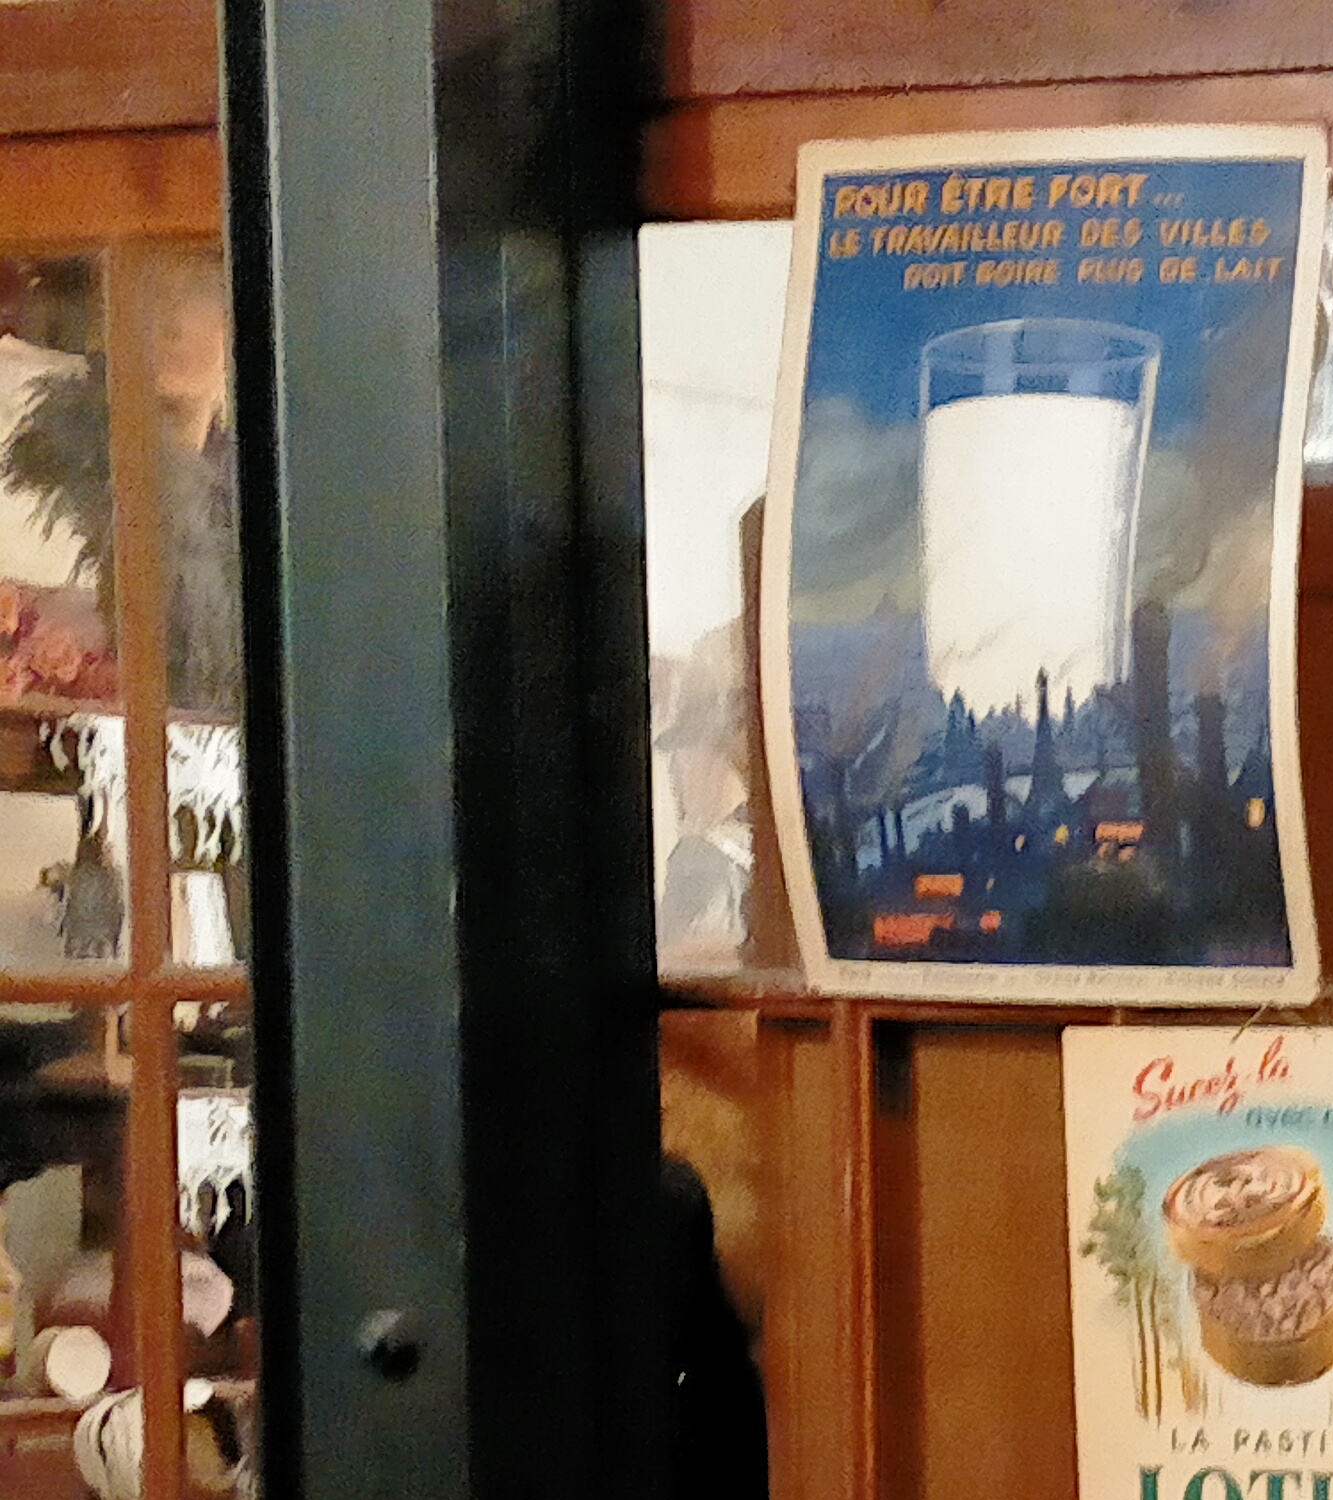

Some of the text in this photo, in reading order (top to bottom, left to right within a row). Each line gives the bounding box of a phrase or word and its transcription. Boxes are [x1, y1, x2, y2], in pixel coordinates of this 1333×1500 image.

[833, 178, 928, 219] POUR
[939, 172, 1035, 214] ÊTRE
[828, 215, 1272, 258] LE TRAVAILLEUR DES VILLES
[902, 255, 1284, 292] DOIT BOIRE PLUS DE LAIT
[1171, 1426, 1210, 1454] LA
